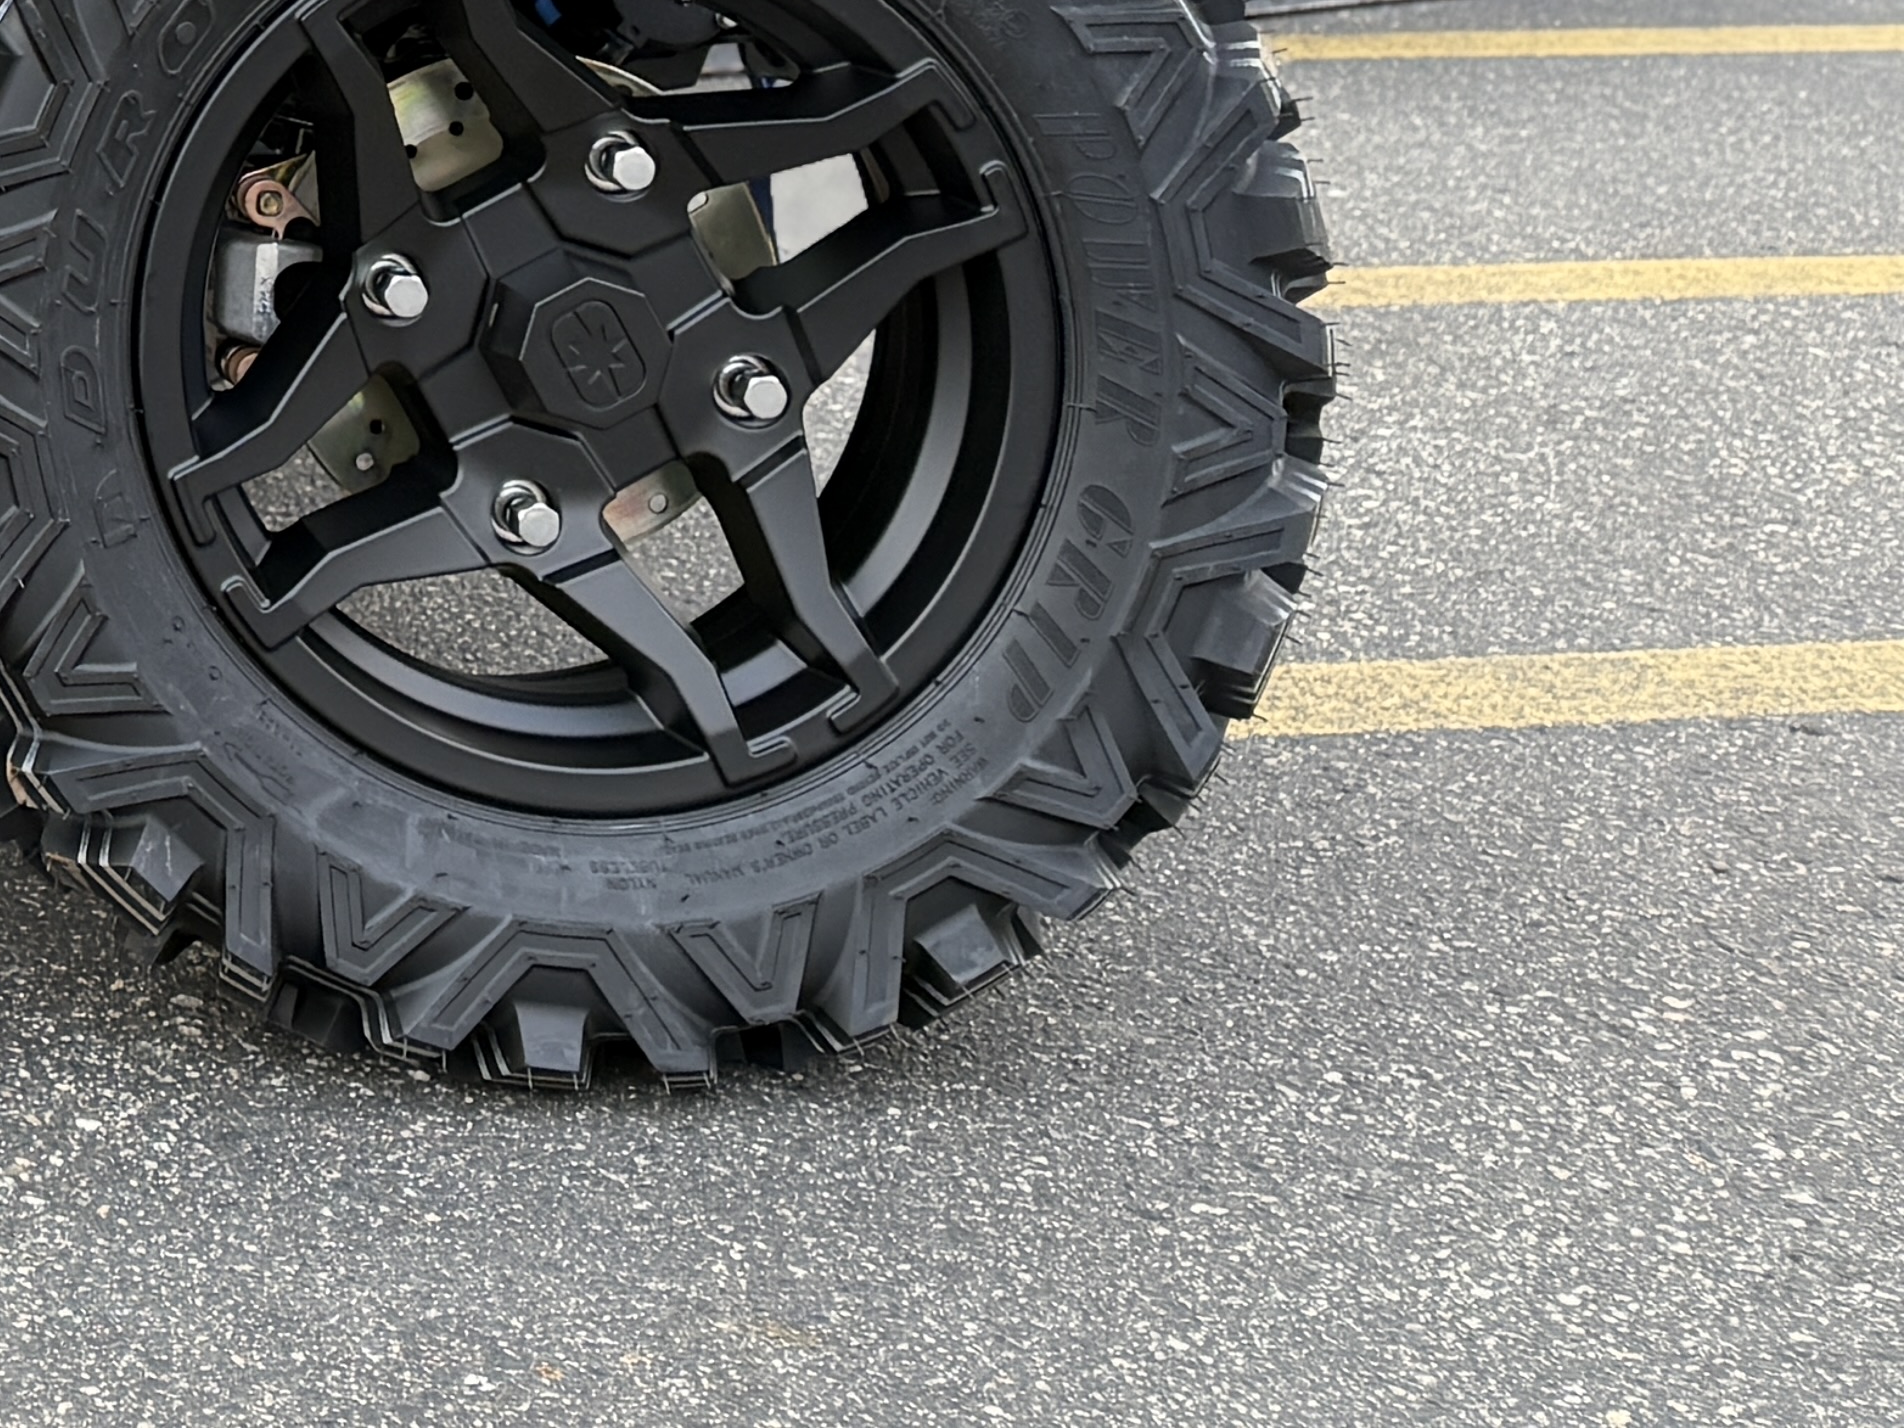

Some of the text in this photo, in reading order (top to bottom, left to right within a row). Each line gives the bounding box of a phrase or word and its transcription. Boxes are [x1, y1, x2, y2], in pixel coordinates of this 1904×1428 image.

[996, 111, 1162, 727] POWER GRIP
[934, 727, 965, 757] FOR
[858, 748, 937, 811] OPERATING
[888, 763, 949, 814] VEHICLE
